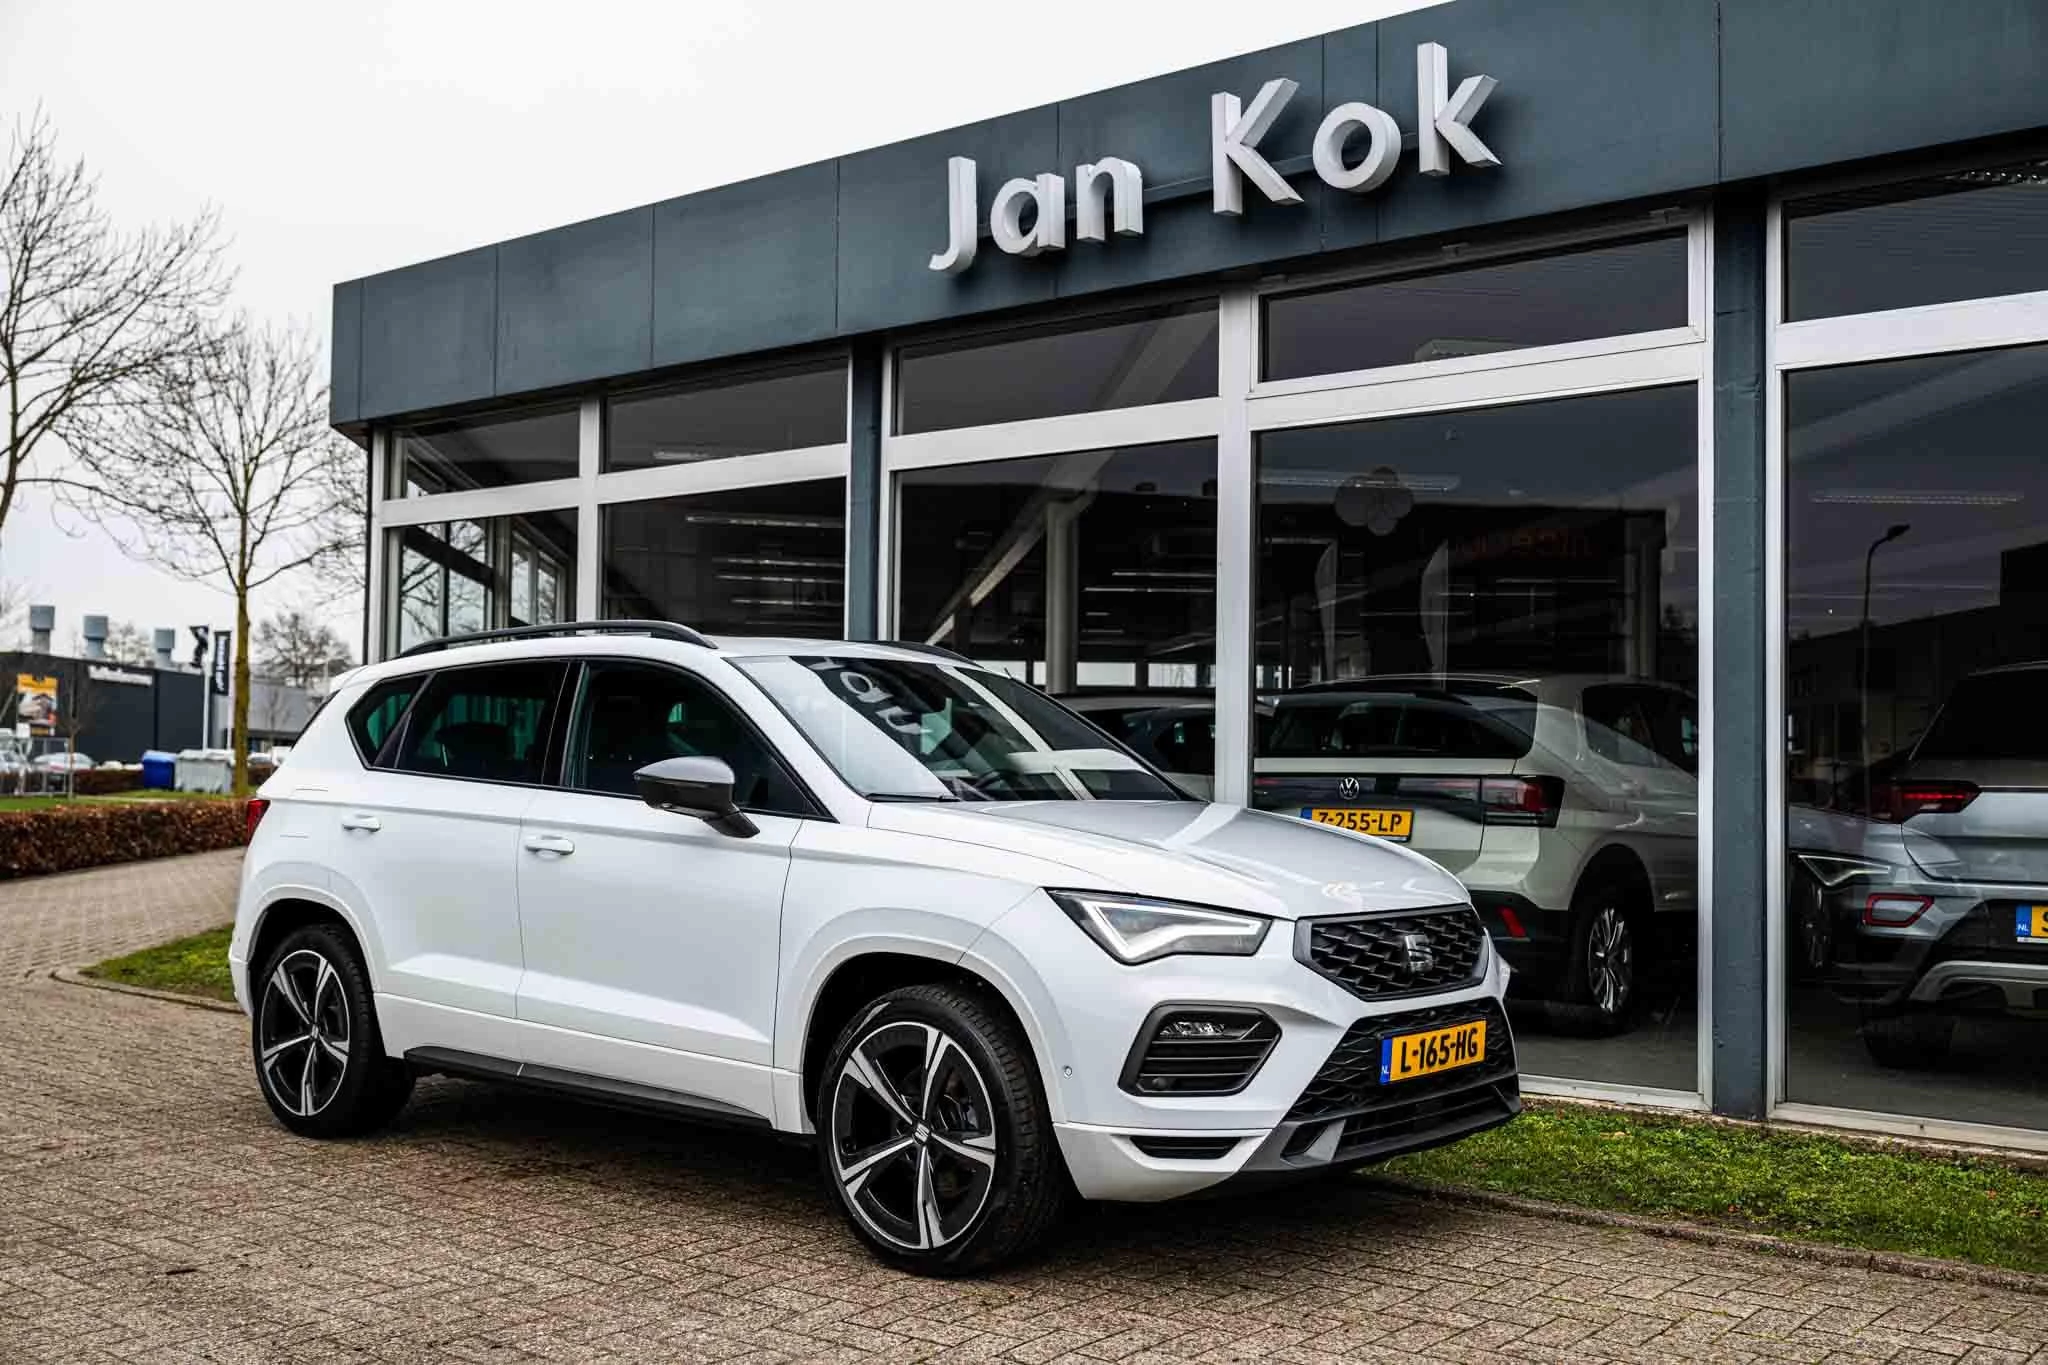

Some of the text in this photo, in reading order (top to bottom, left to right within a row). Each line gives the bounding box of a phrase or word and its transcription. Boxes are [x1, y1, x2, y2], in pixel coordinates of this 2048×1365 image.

[929, 41, 1502, 272] Jan Kok
[1400, 1027, 1478, 1073] L-165-HG
